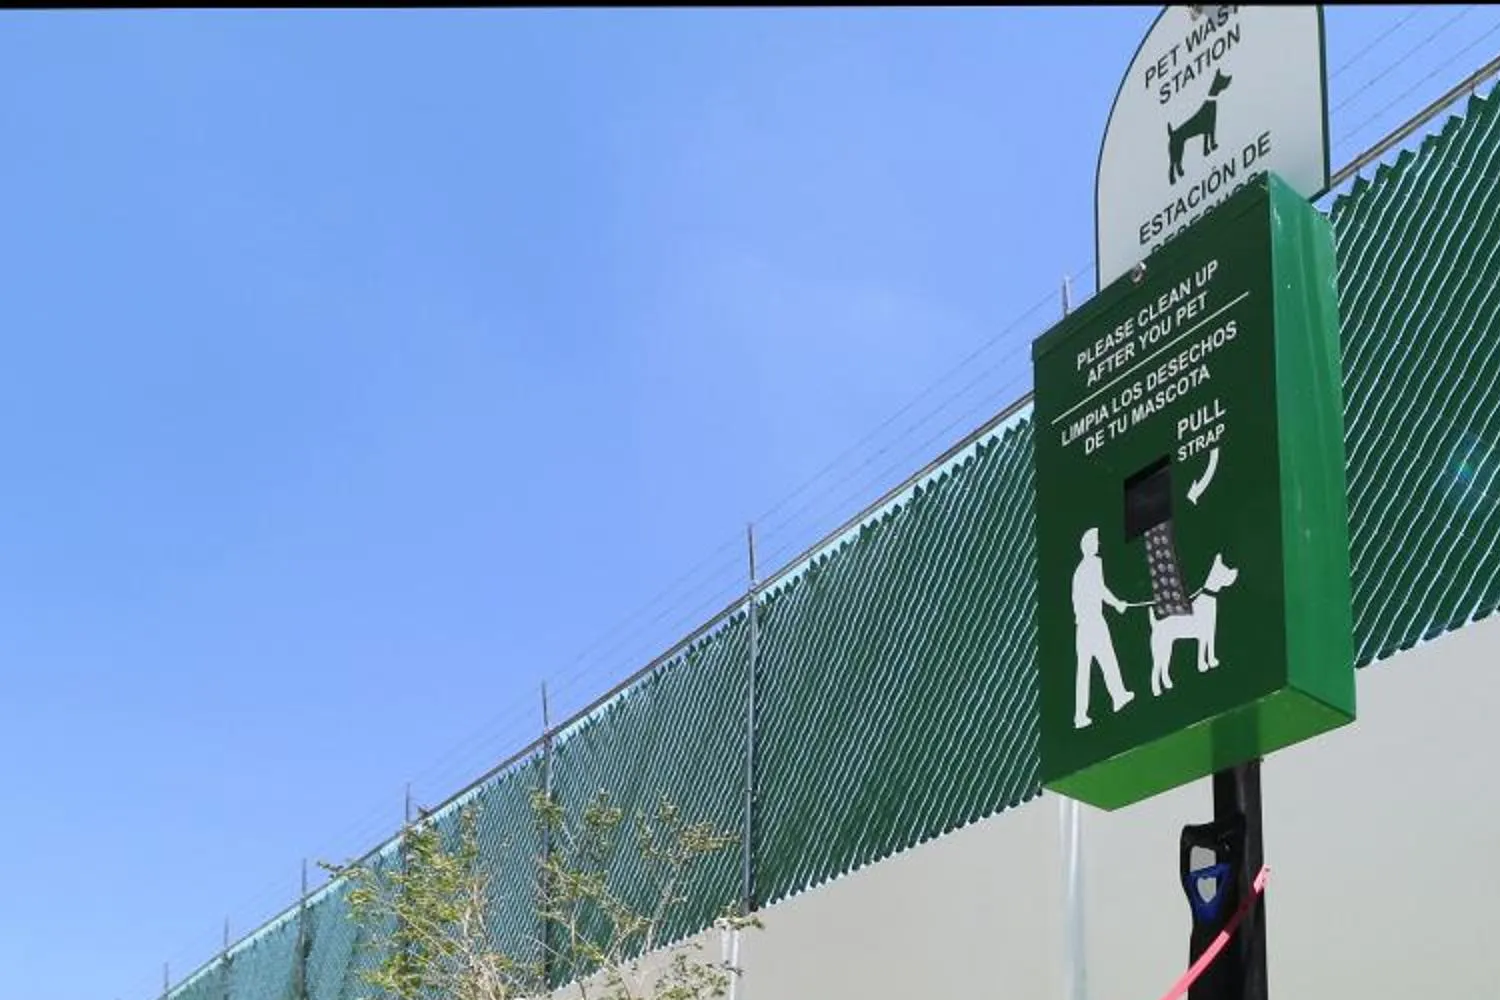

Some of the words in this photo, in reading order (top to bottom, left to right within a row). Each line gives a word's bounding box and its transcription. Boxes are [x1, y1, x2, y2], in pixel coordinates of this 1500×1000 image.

[1145, 44, 1180, 89] PET
[1159, 23, 1240, 104] STATION
[1243, 131, 1272, 168] DE
[1077, 317, 1134, 371] PLEASE
[1137, 277, 1191, 328] CLEAN
[1195, 259, 1219, 288] UP
[1087, 342, 1136, 387] AFTER
[1138, 316, 1172, 351] YOU
[1176, 291, 1208, 327] PET
[1061, 404, 1110, 447] LIMPIA
[1111, 382, 1143, 413] LOS
[1146, 320, 1238, 391] DESECHOS
[1085, 433, 1105, 456] DE
[1108, 413, 1128, 440] TU
[1131, 363, 1211, 425] MASCOTA
[1177, 399, 1227, 441] PULL
[1177, 423, 1226, 462] STRAP
